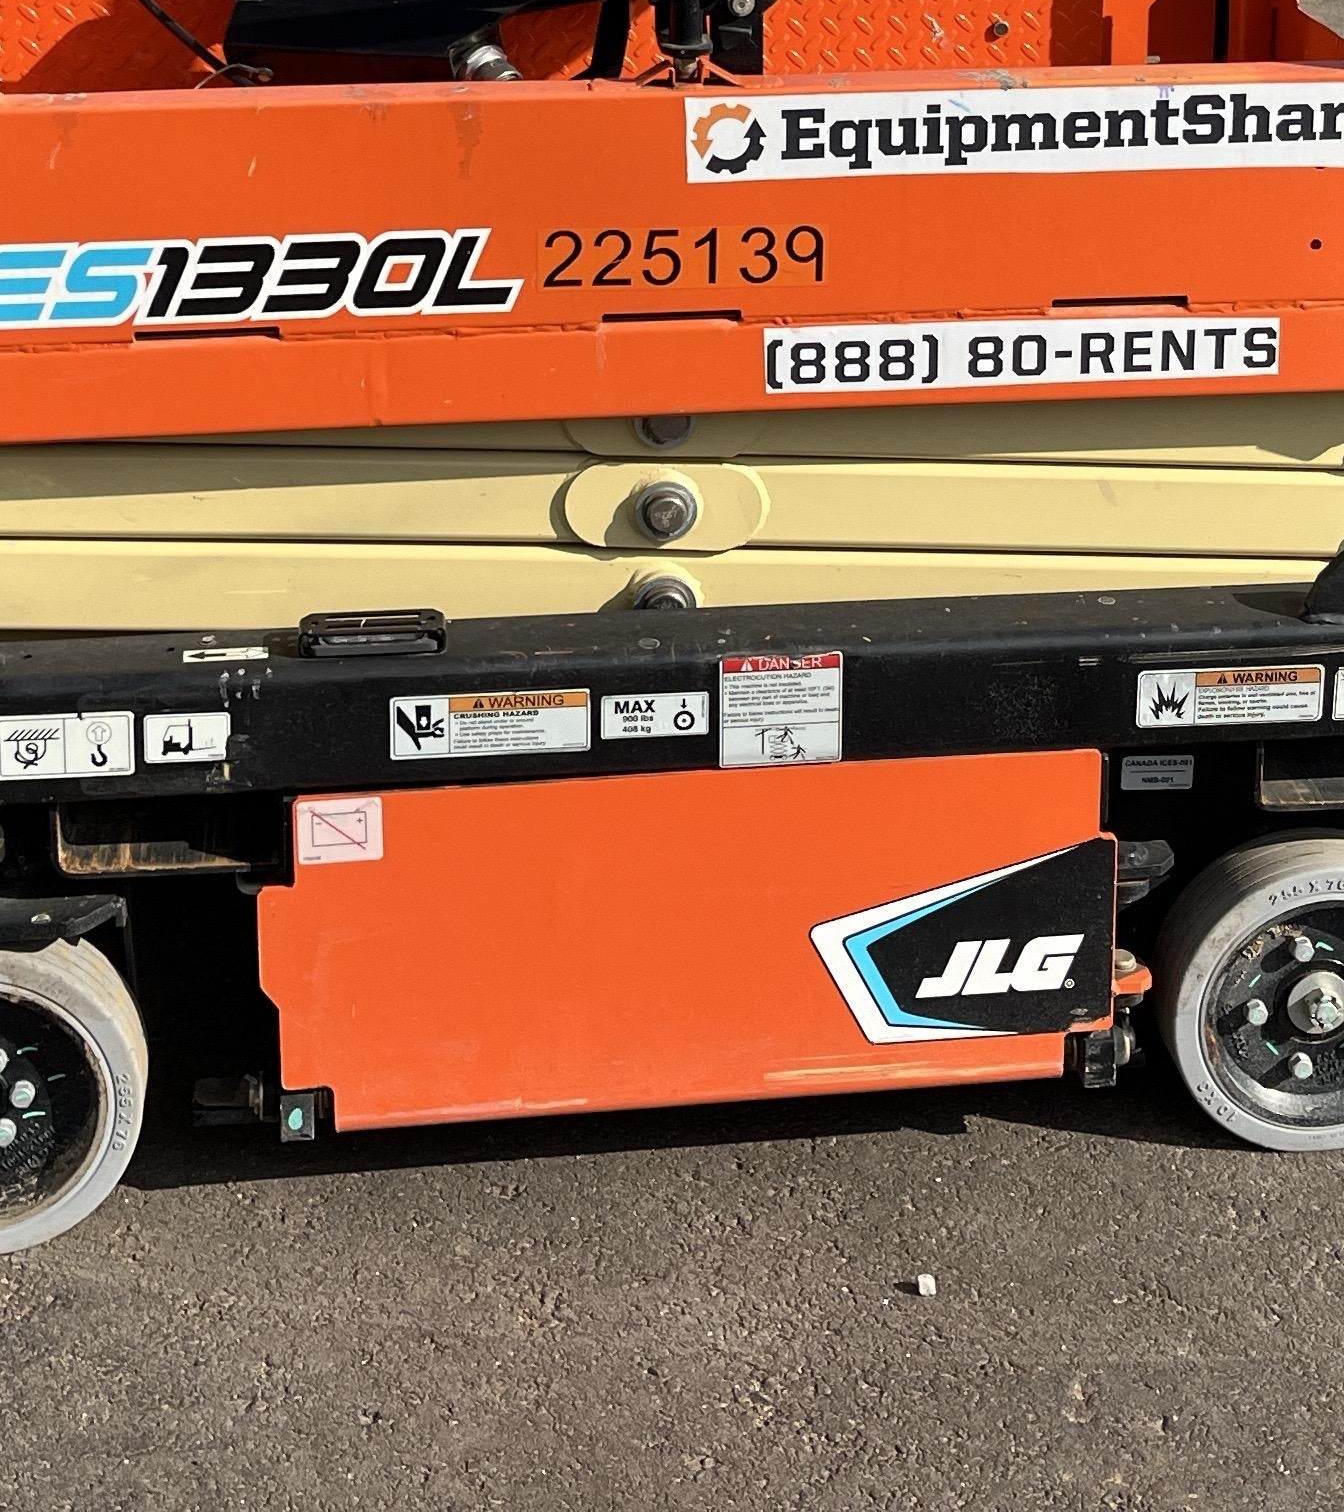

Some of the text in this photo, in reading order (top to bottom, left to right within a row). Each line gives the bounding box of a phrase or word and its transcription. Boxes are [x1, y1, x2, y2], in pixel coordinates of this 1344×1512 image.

[543, 226, 824, 288] 225139
[968, 326, 1277, 378] 80-RENTS
[1233, 671, 1298, 684] WARNING
[488, 694, 565, 709] WARNING
[614, 699, 655, 714] MAX
[454, 709, 539, 720] CRUSHING HAZARD
[640, 725, 652, 733] kg
[915, 934, 1084, 999] JLG
